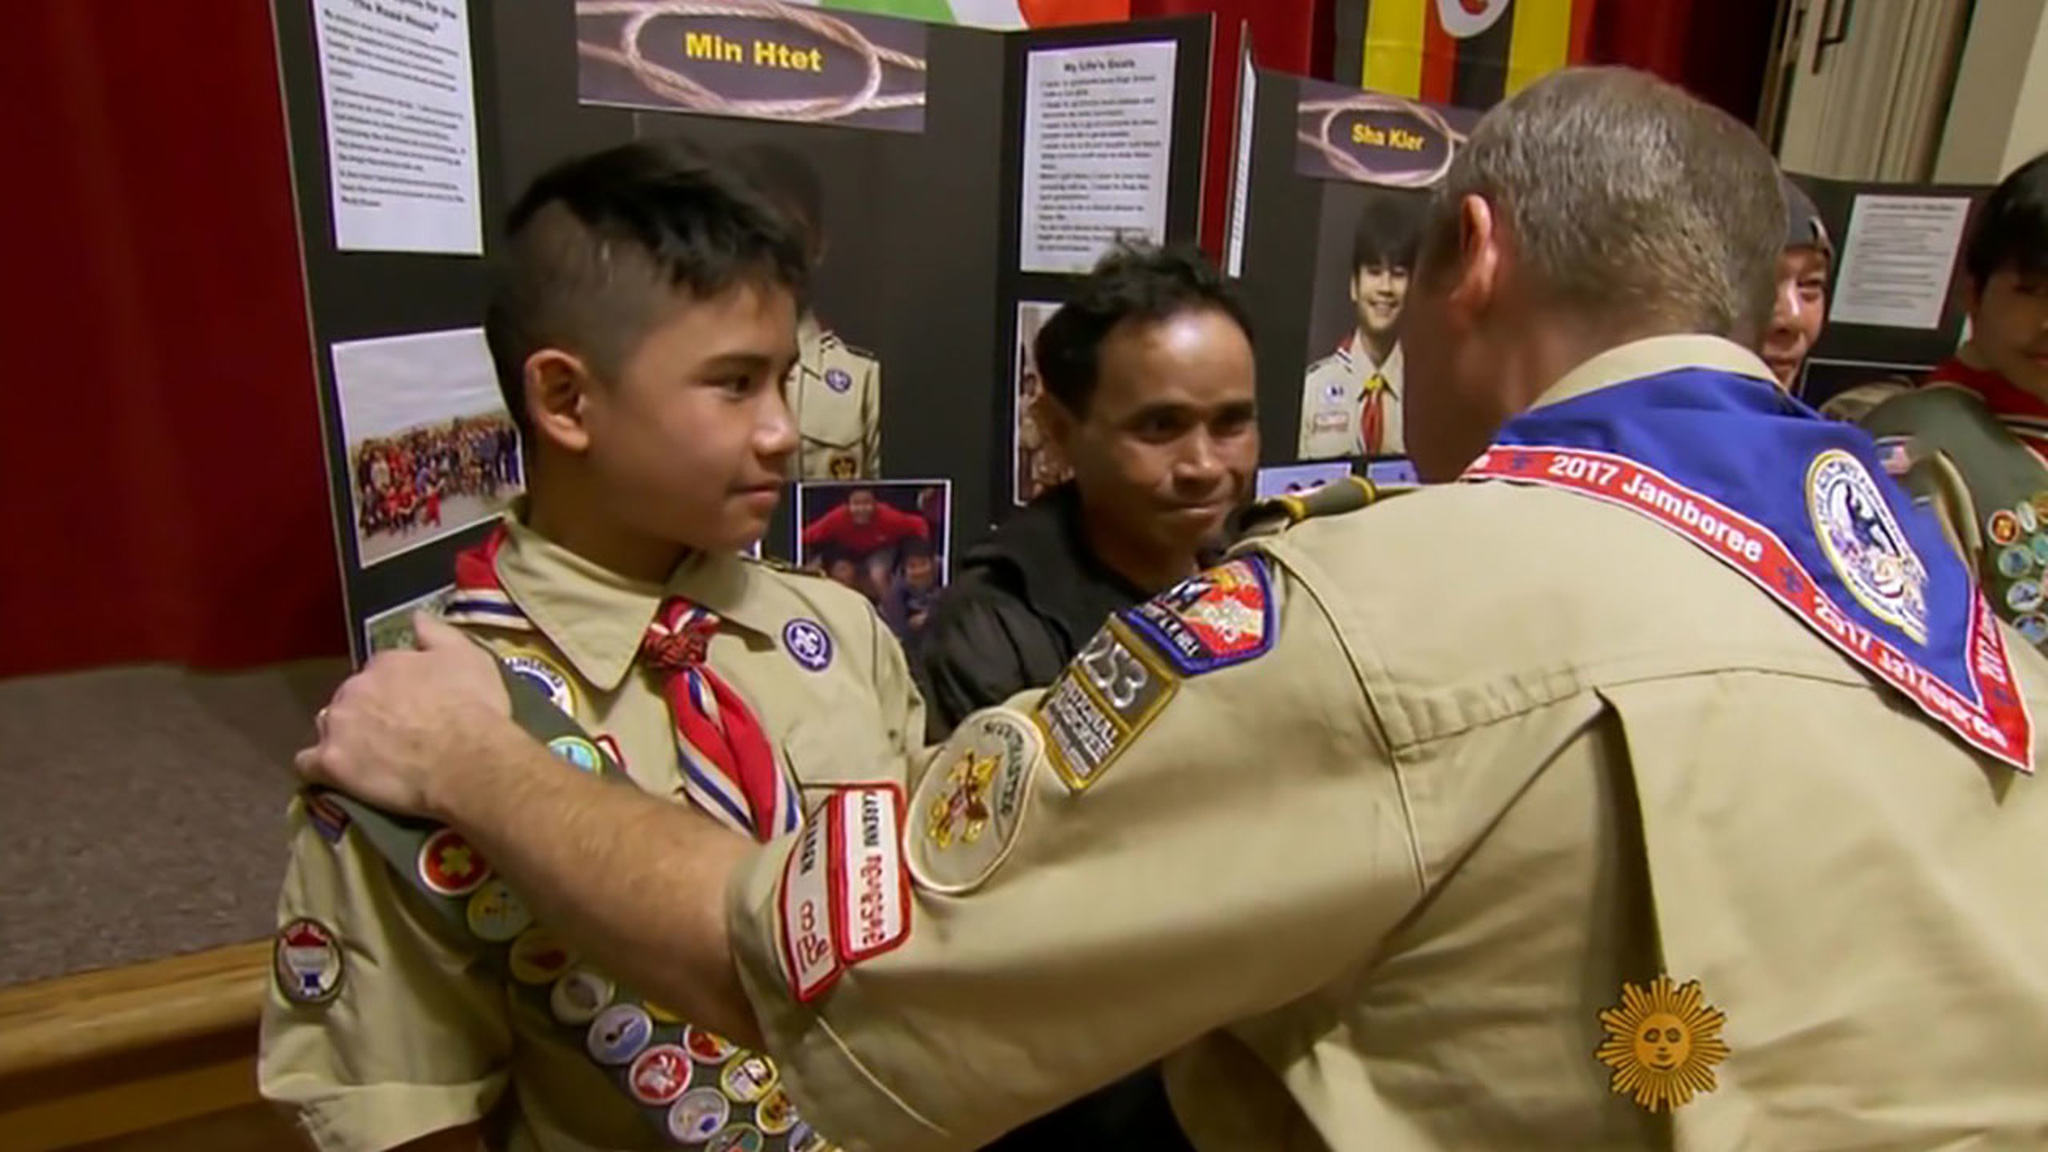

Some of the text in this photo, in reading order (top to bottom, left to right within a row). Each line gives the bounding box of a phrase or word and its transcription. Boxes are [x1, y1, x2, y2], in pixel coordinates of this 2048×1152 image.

[685, 32, 823, 73] Min Htet
[1352, 123, 1386, 147] Sha
[1547, 453, 1620, 486] 2017
[1620, 473, 1764, 563] Jamboree
